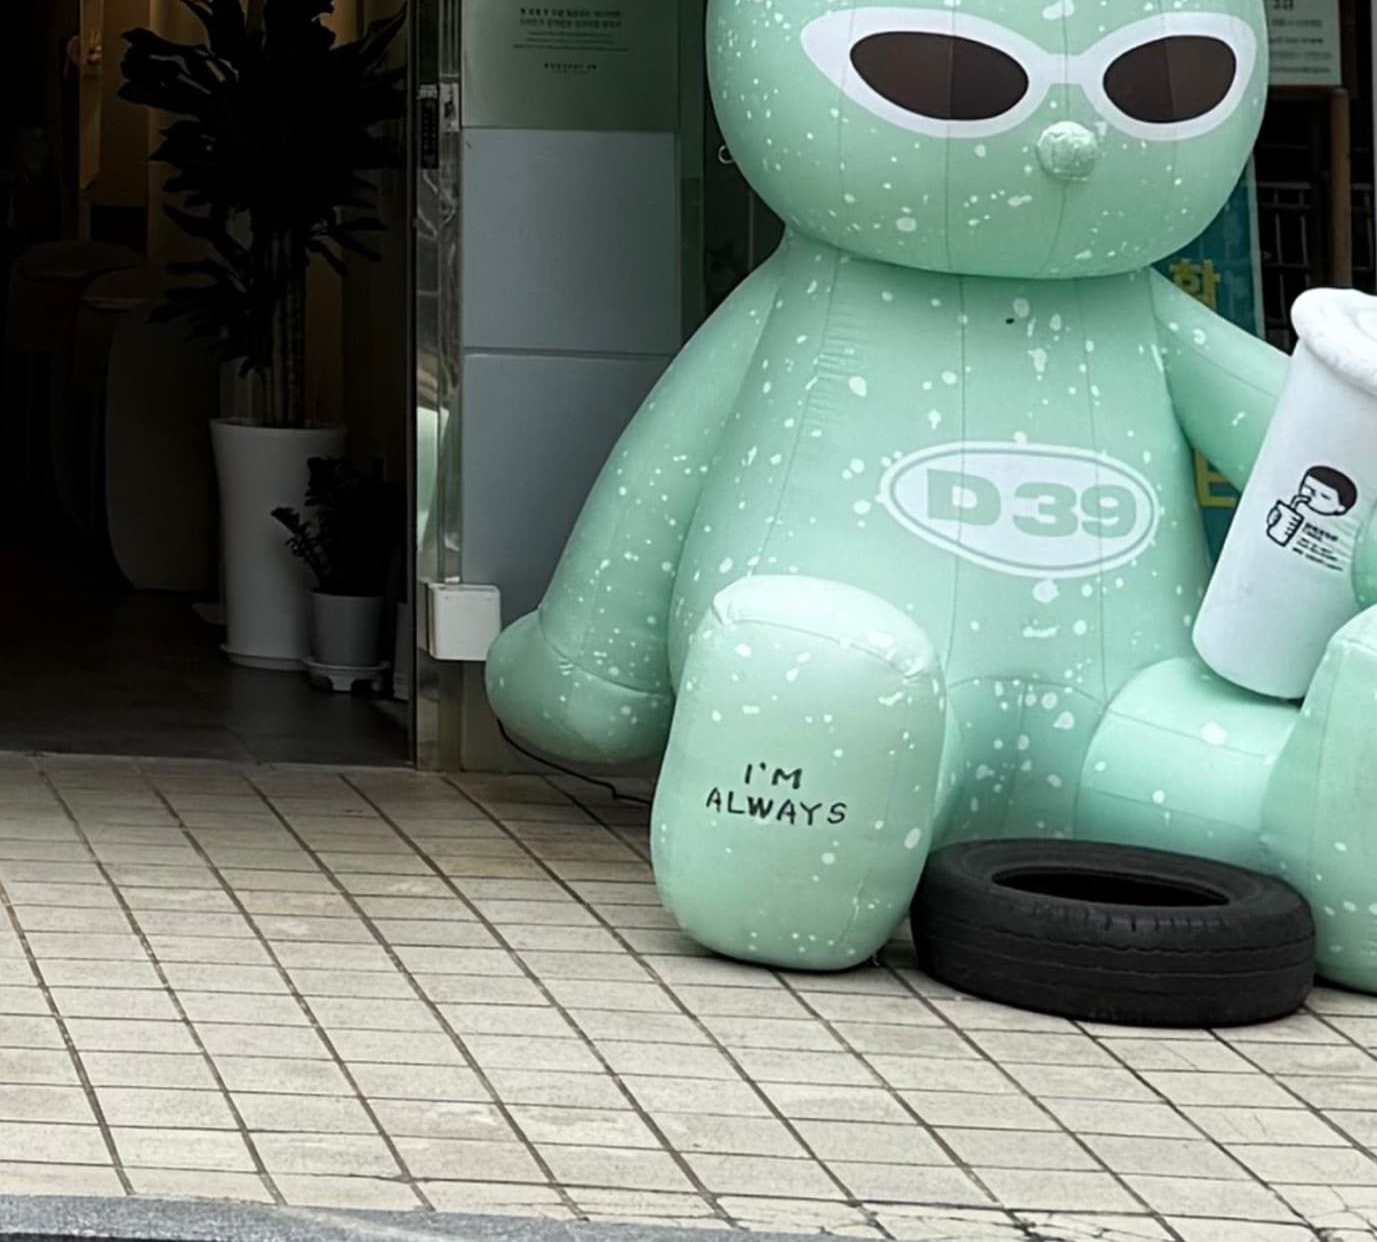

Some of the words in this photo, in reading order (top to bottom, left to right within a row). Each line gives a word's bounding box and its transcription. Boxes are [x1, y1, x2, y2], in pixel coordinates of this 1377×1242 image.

[927, 467, 1137, 540] D39
[744, 762, 802, 789] I'M
[706, 787, 847, 826] ALWAYS
